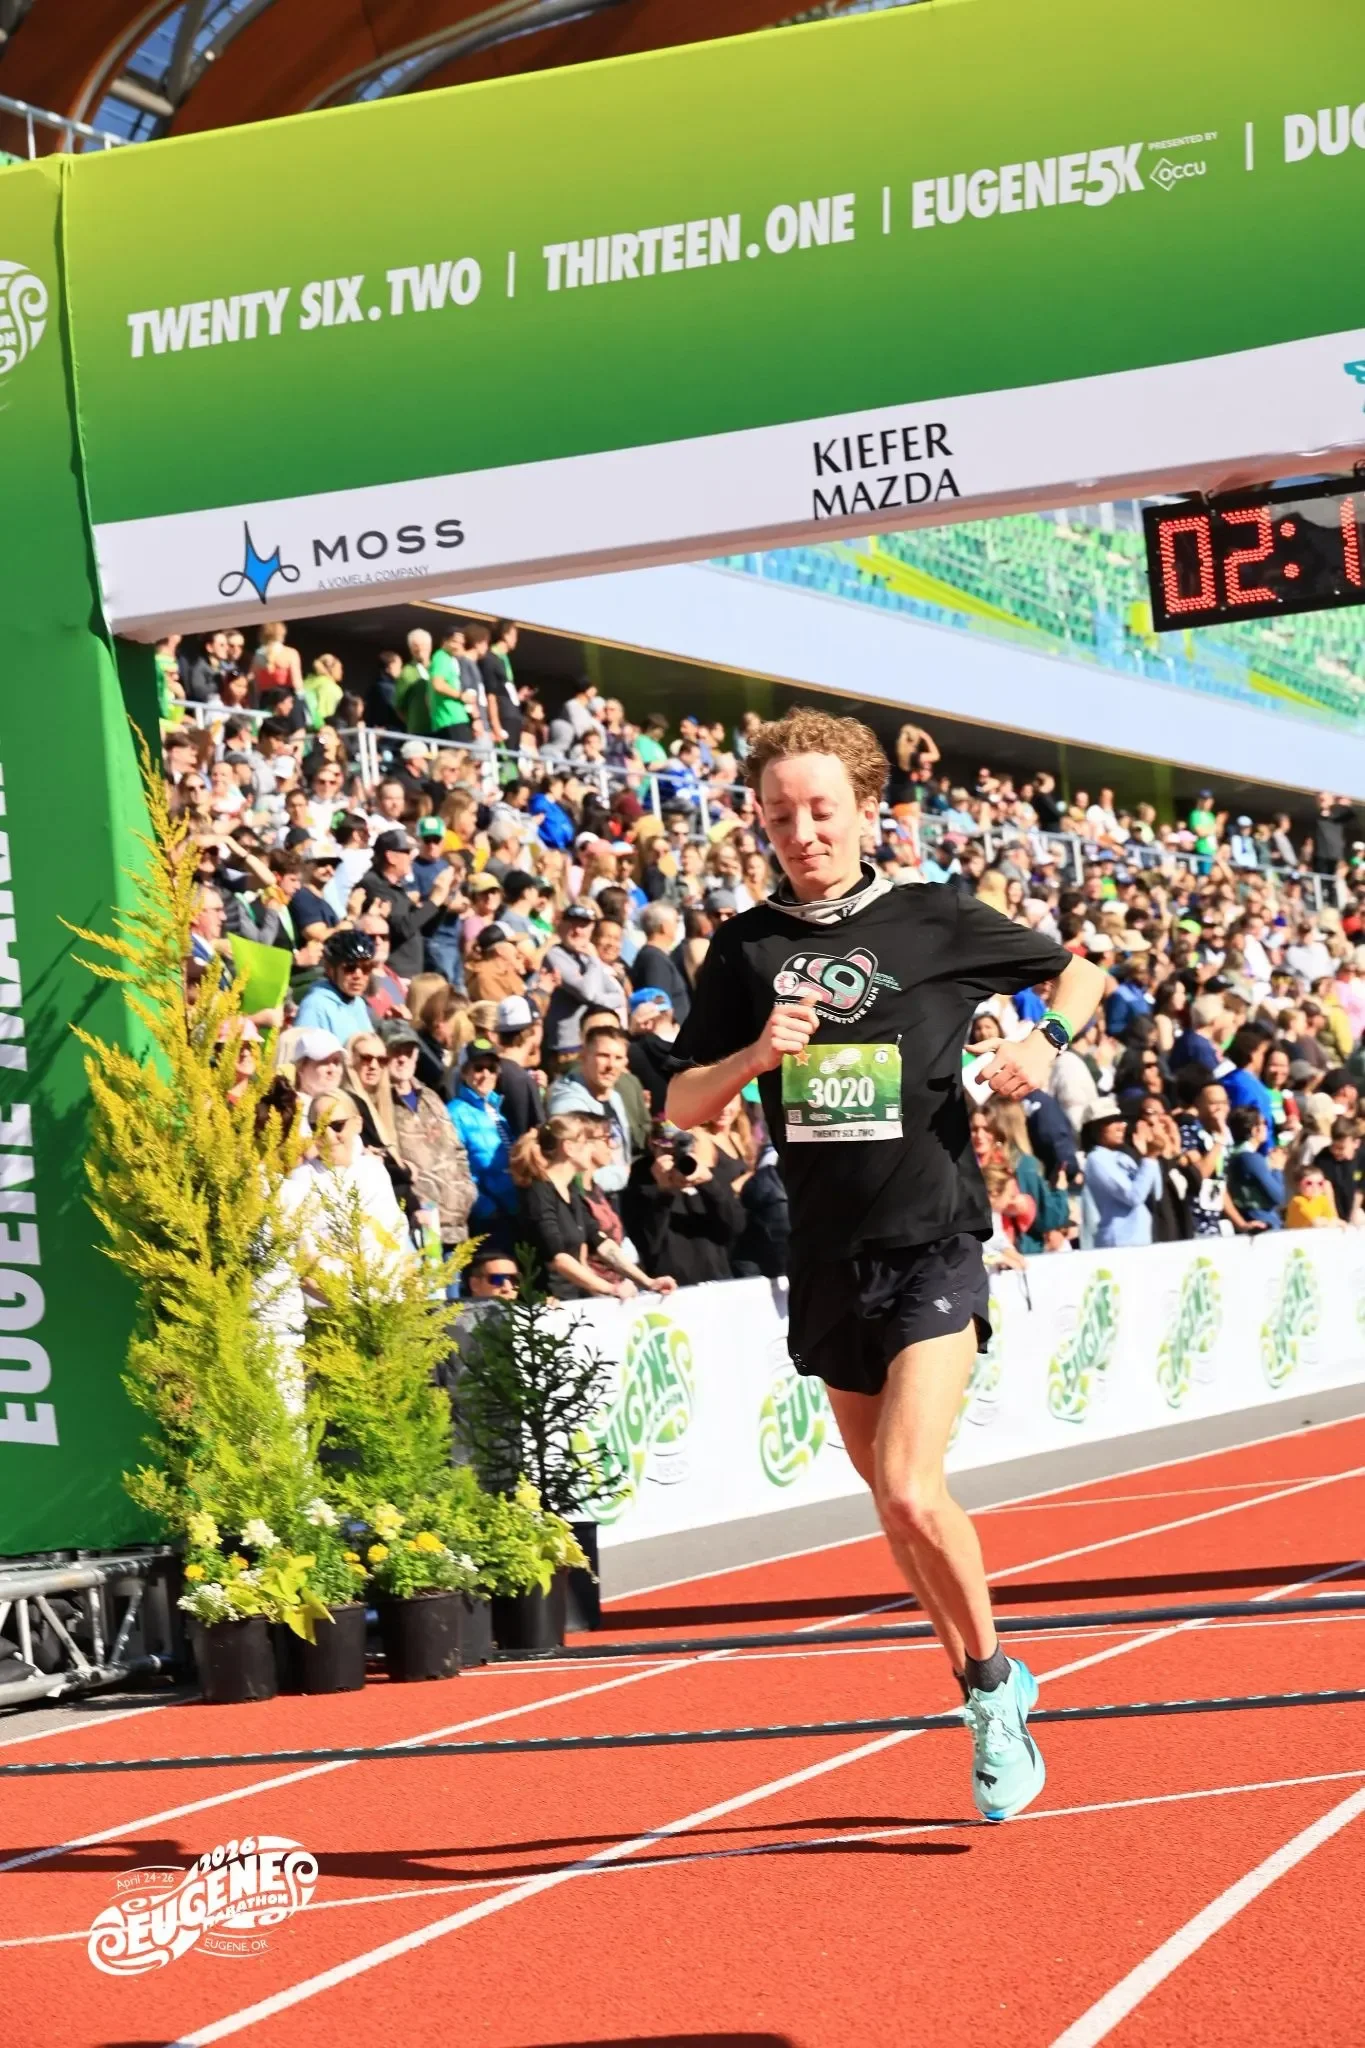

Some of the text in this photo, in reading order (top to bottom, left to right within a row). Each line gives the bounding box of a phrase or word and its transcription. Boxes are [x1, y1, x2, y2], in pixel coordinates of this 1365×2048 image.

[1148, 131, 1218, 151] PRESENTED BY
[911, 142, 1145, 229] EUGENE5K
[1158, 160, 1207, 182] OCCU
[127, 287, 290, 357] TWENTY
[813, 423, 954, 477] KIEFER
[812, 468, 961, 521] MAZDA
[312, 519, 465, 567] MOSS
[374, 564, 430, 582] COMPANY
[813, 986, 880, 1025] DVENTURE RUN
[807, 1076, 876, 1109] 3020
[811, 1128, 841, 1139] TWENTY
